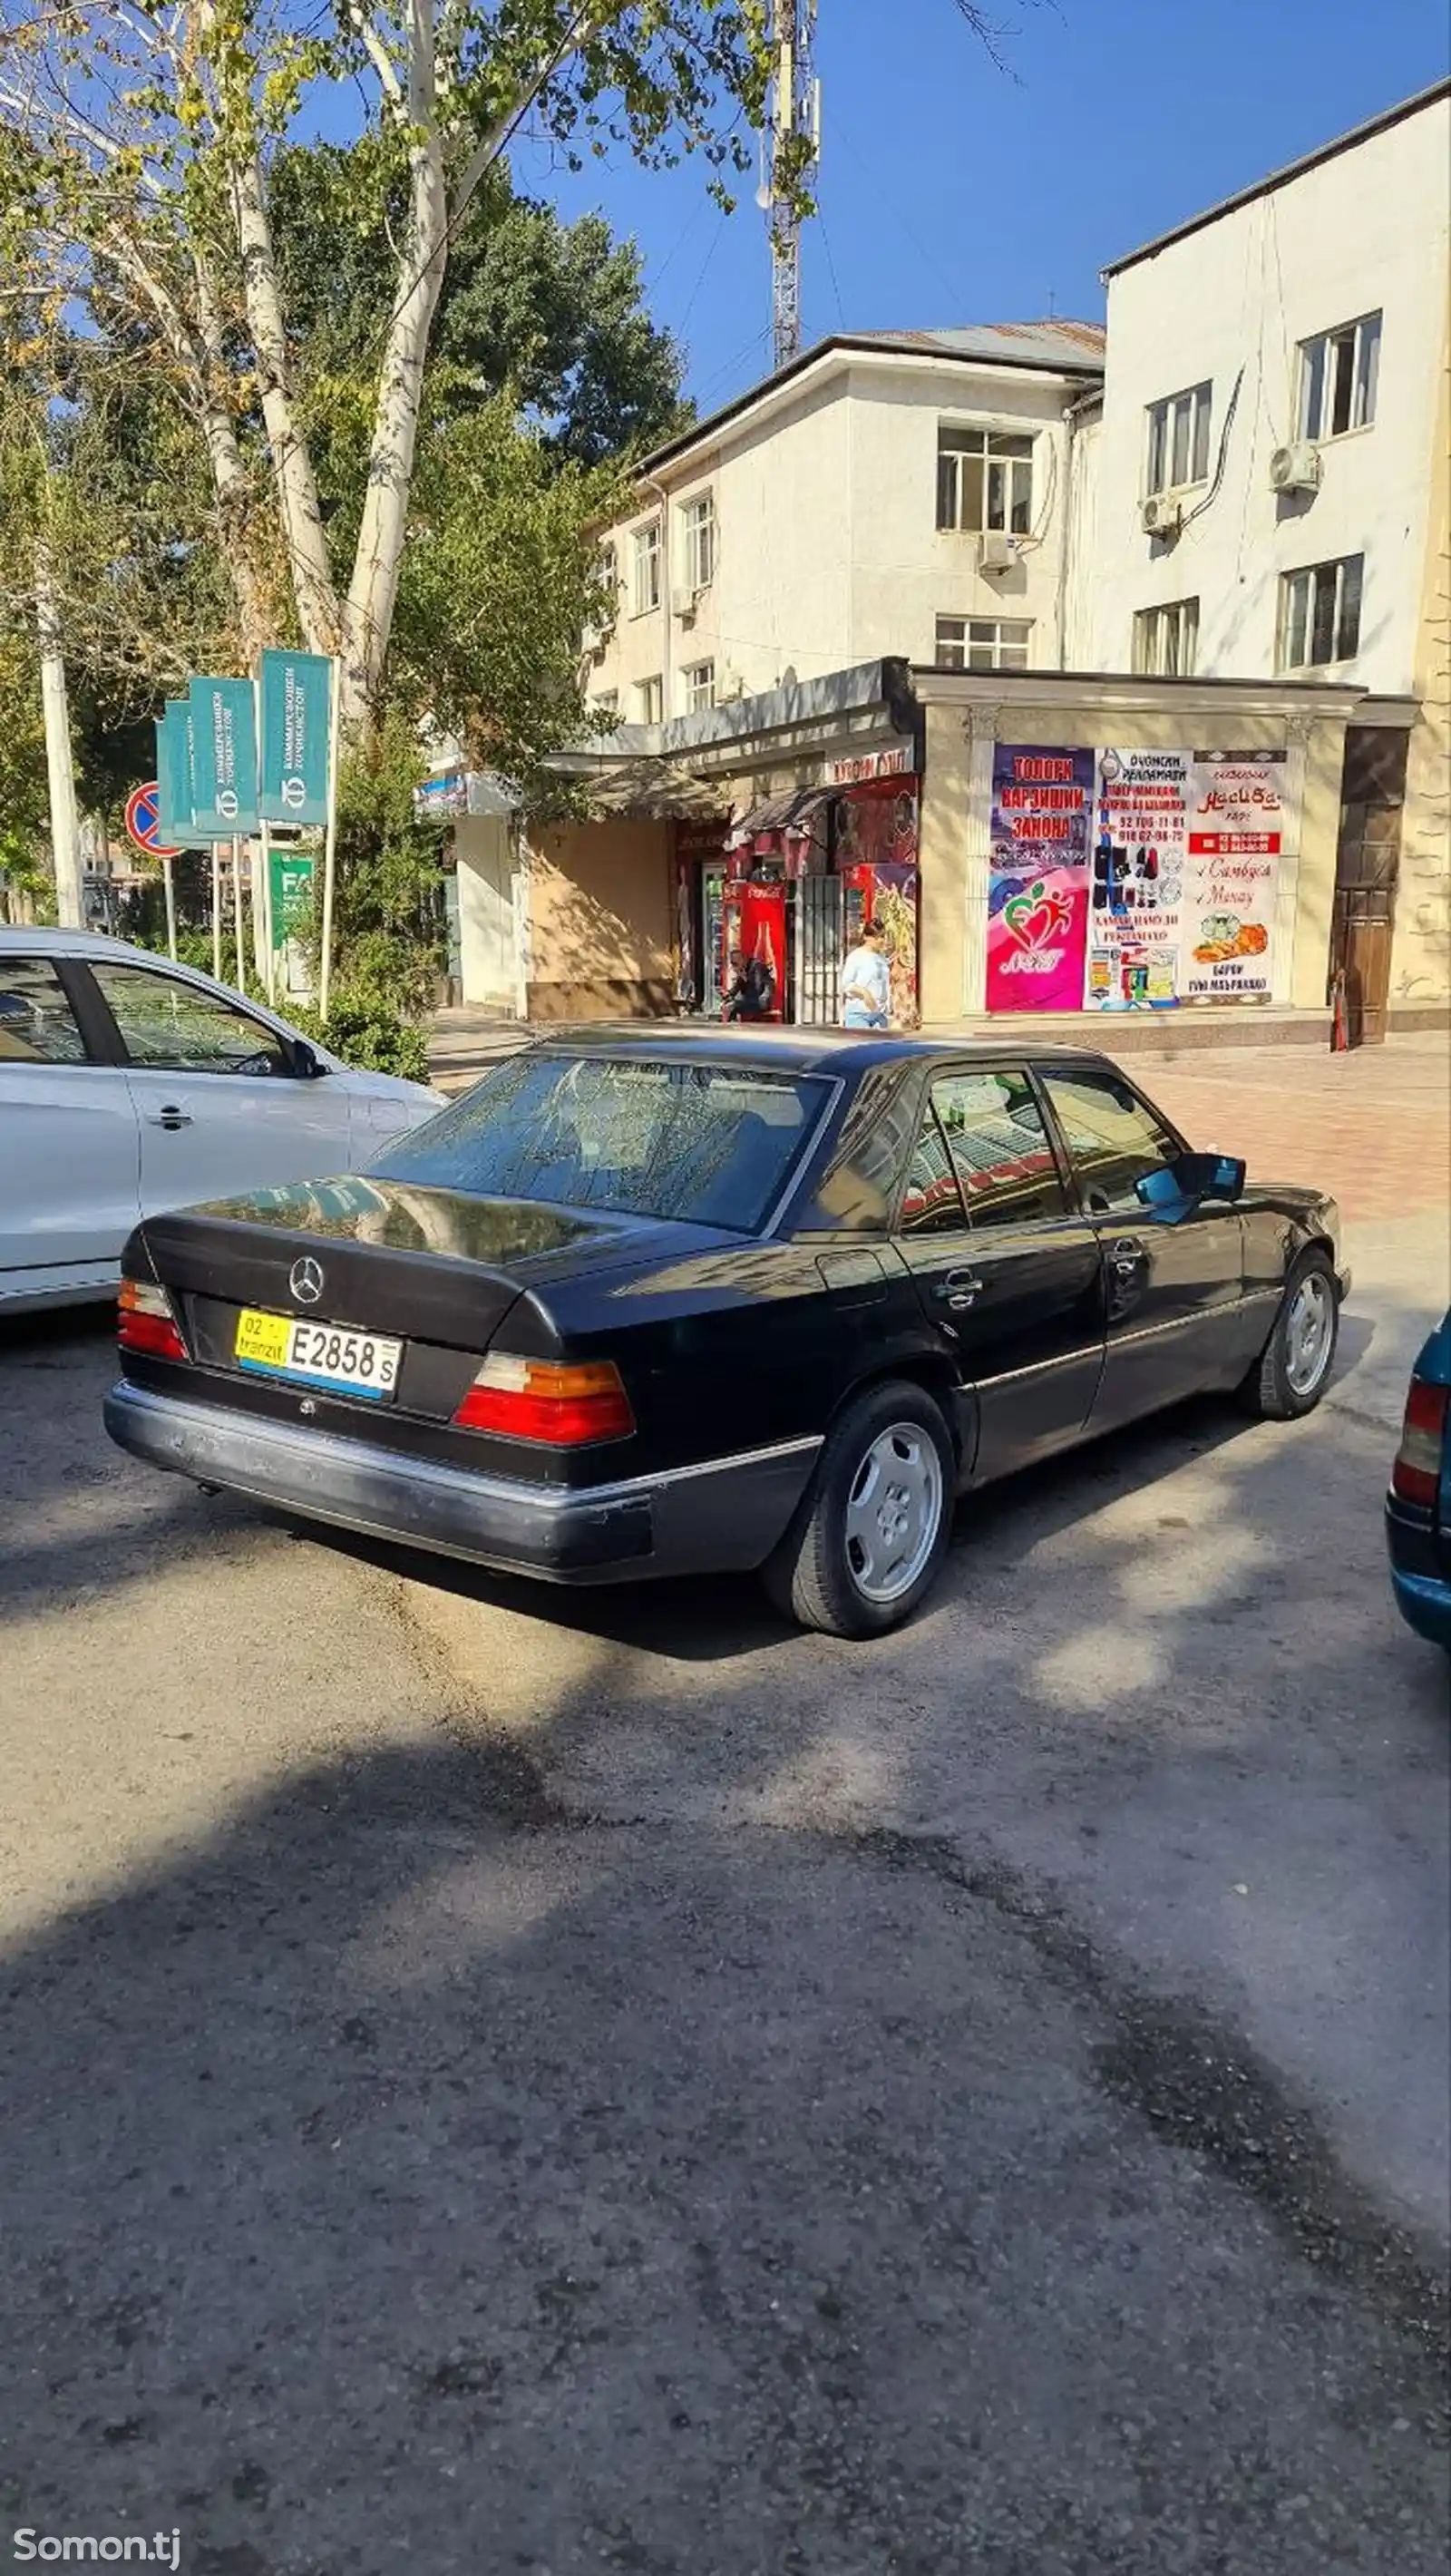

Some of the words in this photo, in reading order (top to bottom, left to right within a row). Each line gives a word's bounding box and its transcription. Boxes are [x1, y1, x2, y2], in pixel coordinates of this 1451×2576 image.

[245, 1318, 263, 1335] 02
[239, 1336, 283, 1361] tranzit
[292, 1327, 375, 1378] E2858
